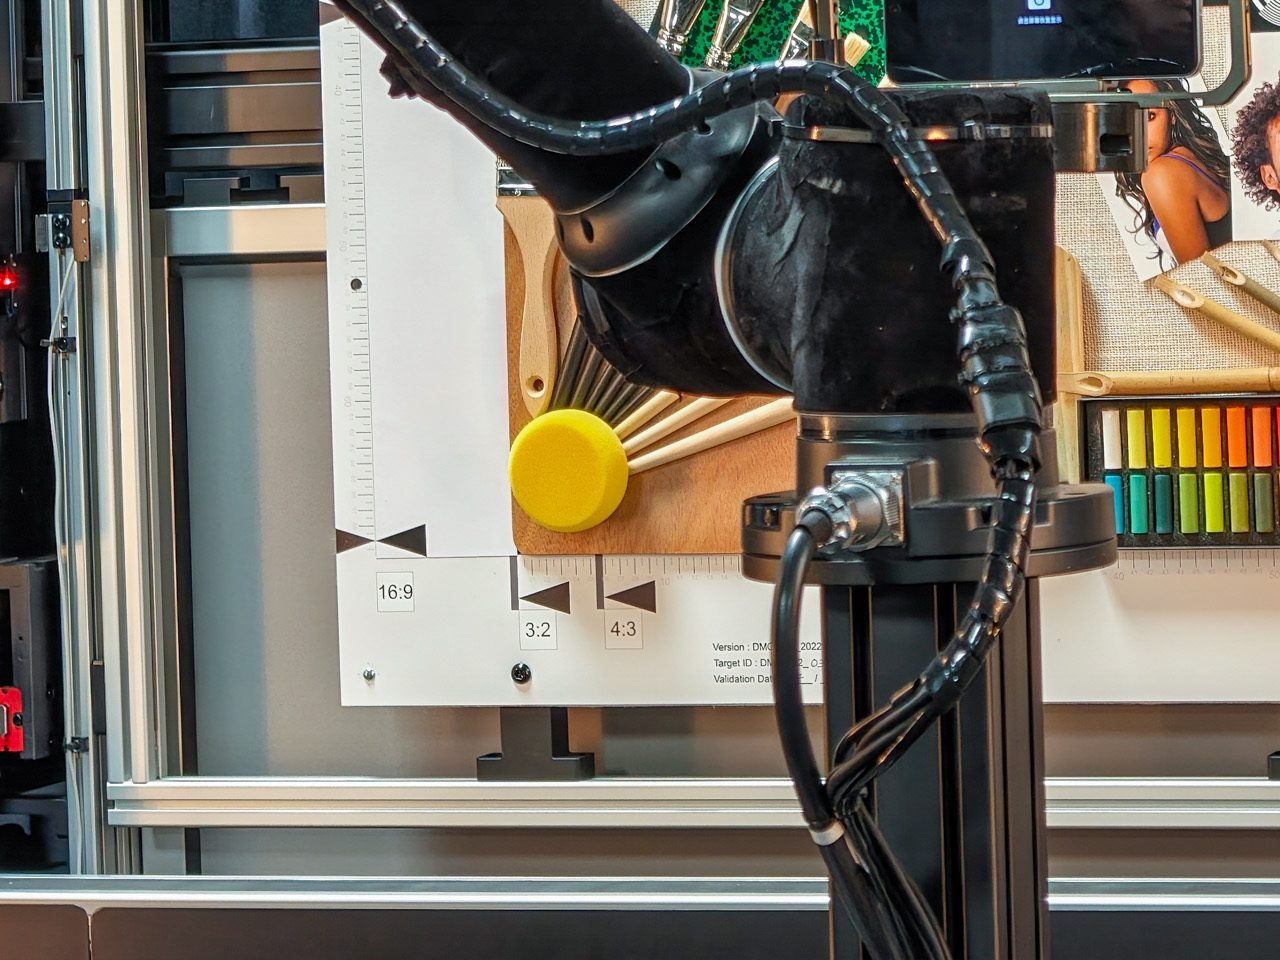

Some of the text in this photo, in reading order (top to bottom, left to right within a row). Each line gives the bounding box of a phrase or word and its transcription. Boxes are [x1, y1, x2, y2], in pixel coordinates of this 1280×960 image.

[378, 584, 414, 601] 16:9
[526, 621, 551, 639] 3:2
[610, 621, 636, 638] 4:3
[712, 642, 745, 651] Version
[714, 659, 740, 669] Target
[743, 659, 752, 667] ID
[713, 675, 755, 683] Validation
